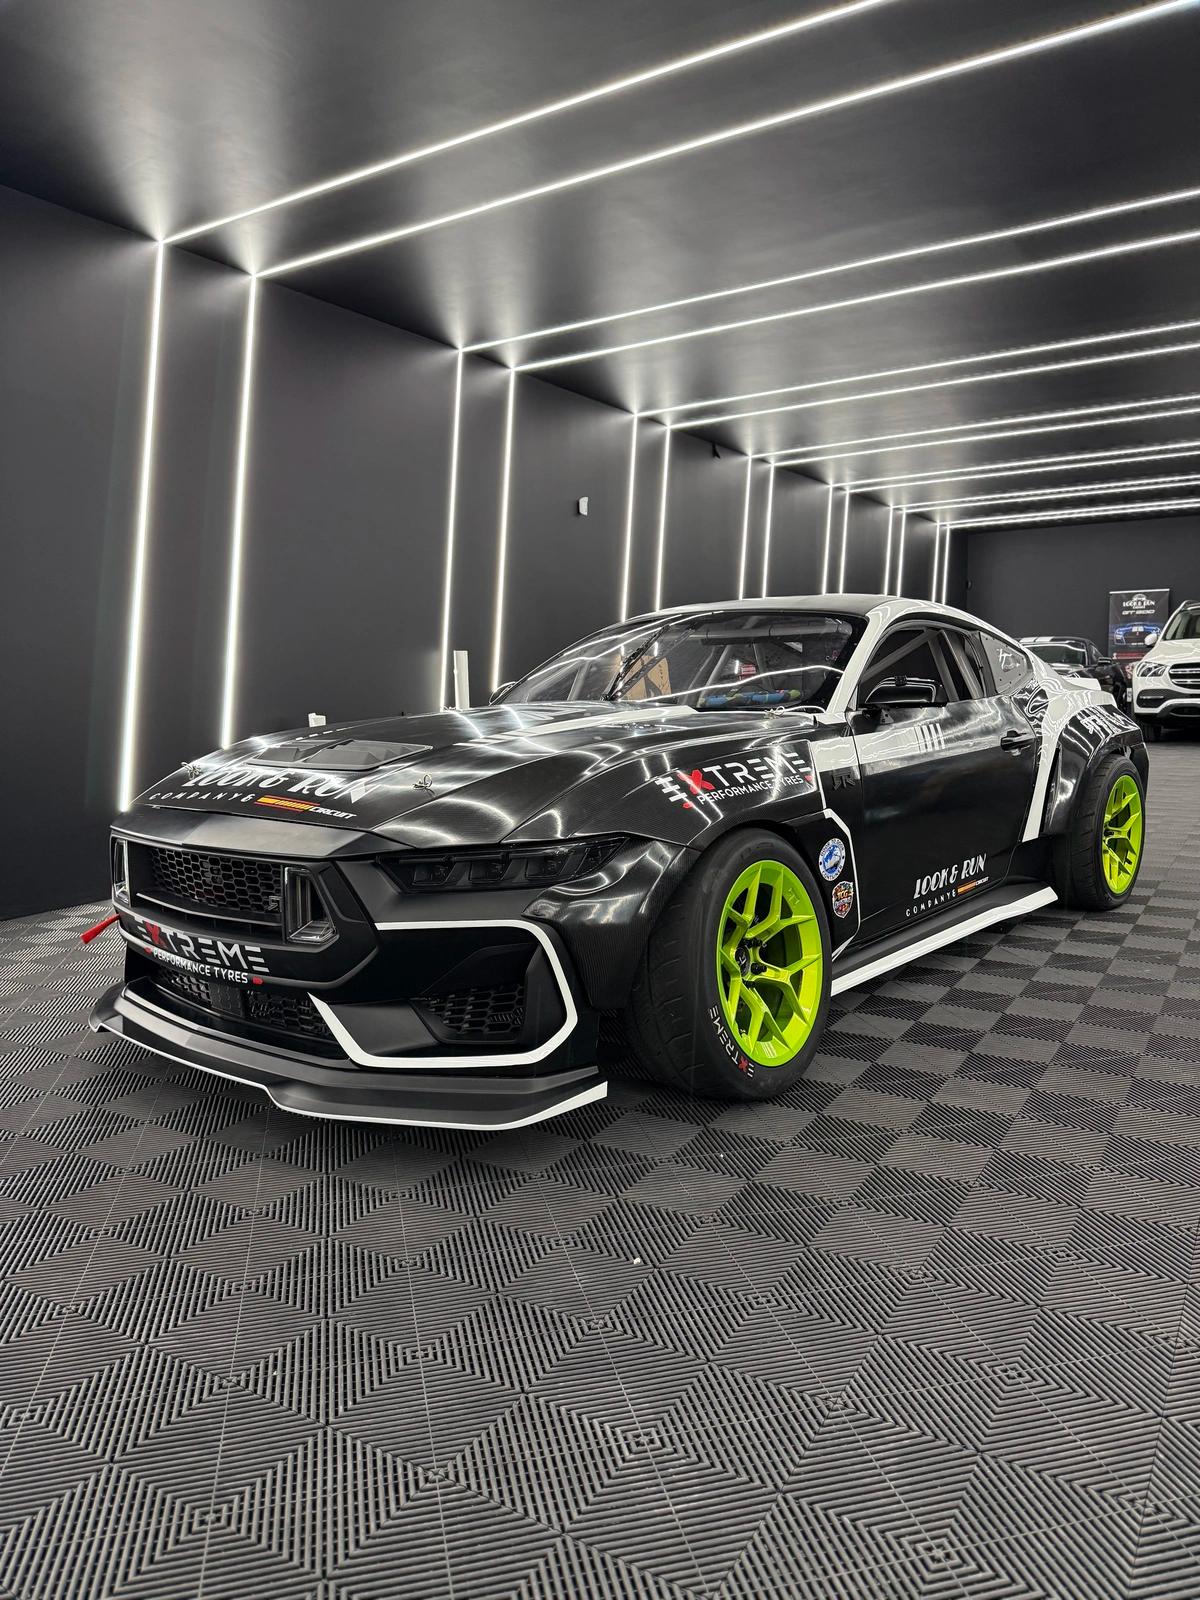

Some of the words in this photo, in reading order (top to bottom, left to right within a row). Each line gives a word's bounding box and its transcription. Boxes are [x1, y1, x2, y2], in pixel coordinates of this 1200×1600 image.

[654, 751, 812, 803] EXTREME
[696, 779, 772, 805] PERFORMANCE
[772, 775, 804, 793] TYRES
[149, 791, 237, 801] COMPANY
[309, 806, 357, 820] CIRCUIT
[913, 867, 950, 899] LOOK
[961, 852, 987, 879] RUN
[905, 892, 950, 917] COMPANY
[134, 915, 270, 973] EXTREME
[152, 948, 212, 977] PERFORMANCE
[213, 965, 249, 984] TYRES
[709, 1005, 755, 1078] EXTREME
